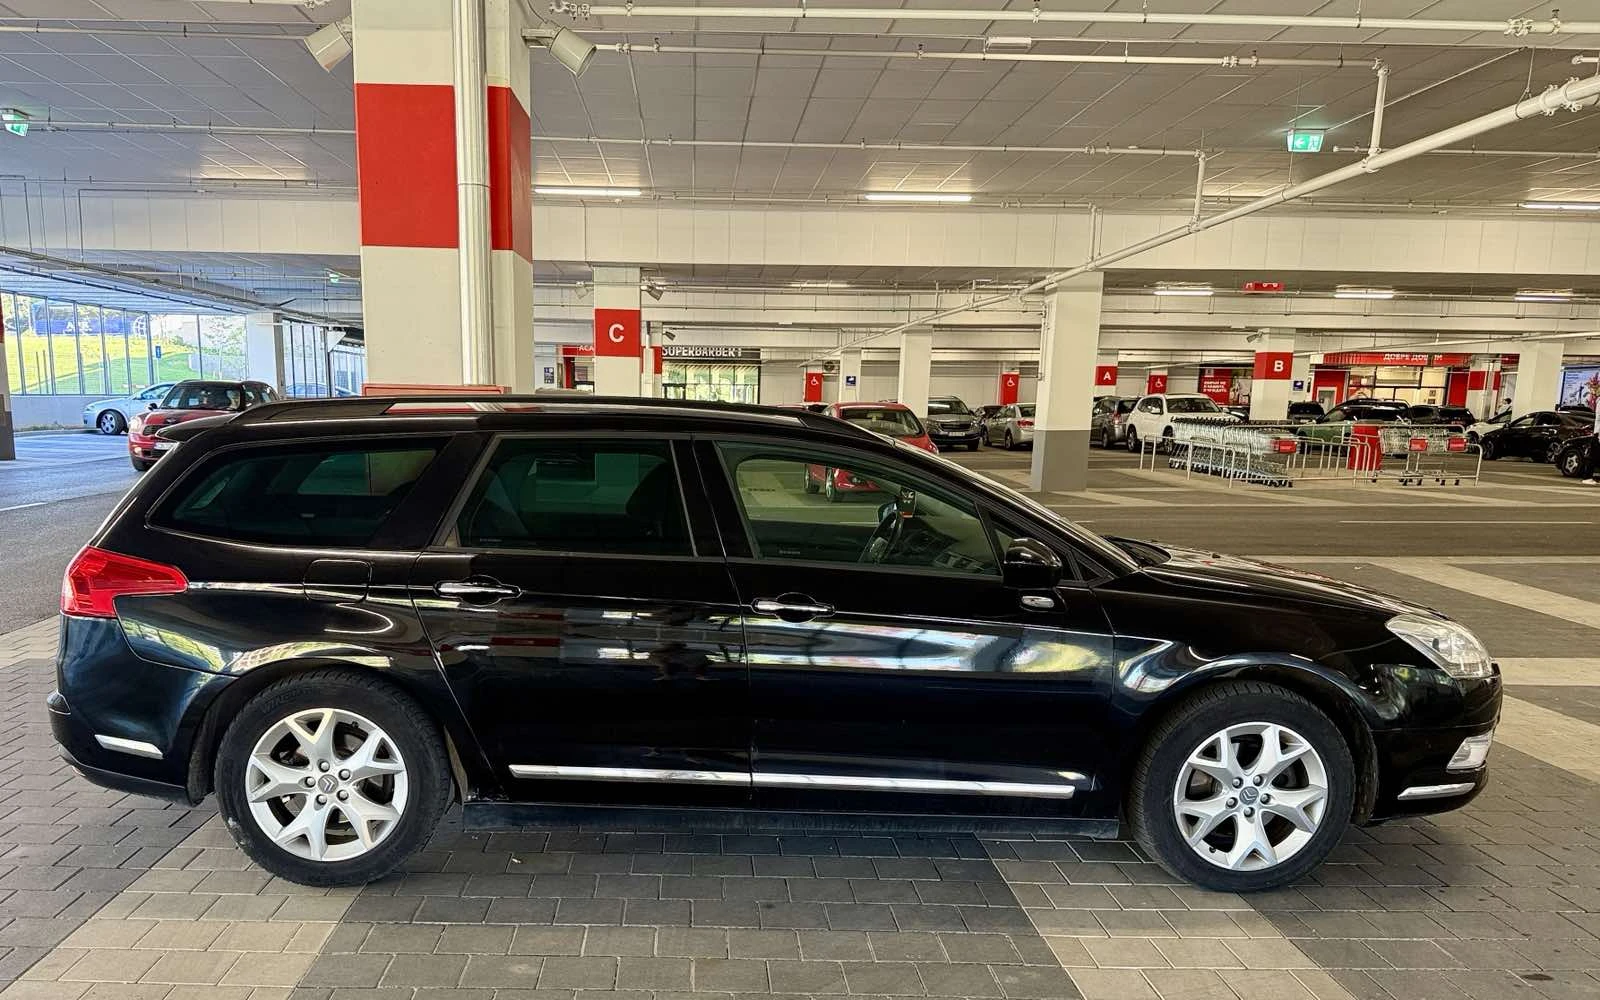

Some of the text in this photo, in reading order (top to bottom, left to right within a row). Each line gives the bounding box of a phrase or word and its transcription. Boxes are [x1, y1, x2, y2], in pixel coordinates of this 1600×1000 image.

[608, 323, 625, 343] C
[1273, 360, 1284, 372] B
[1103, 371, 1112, 381] A
